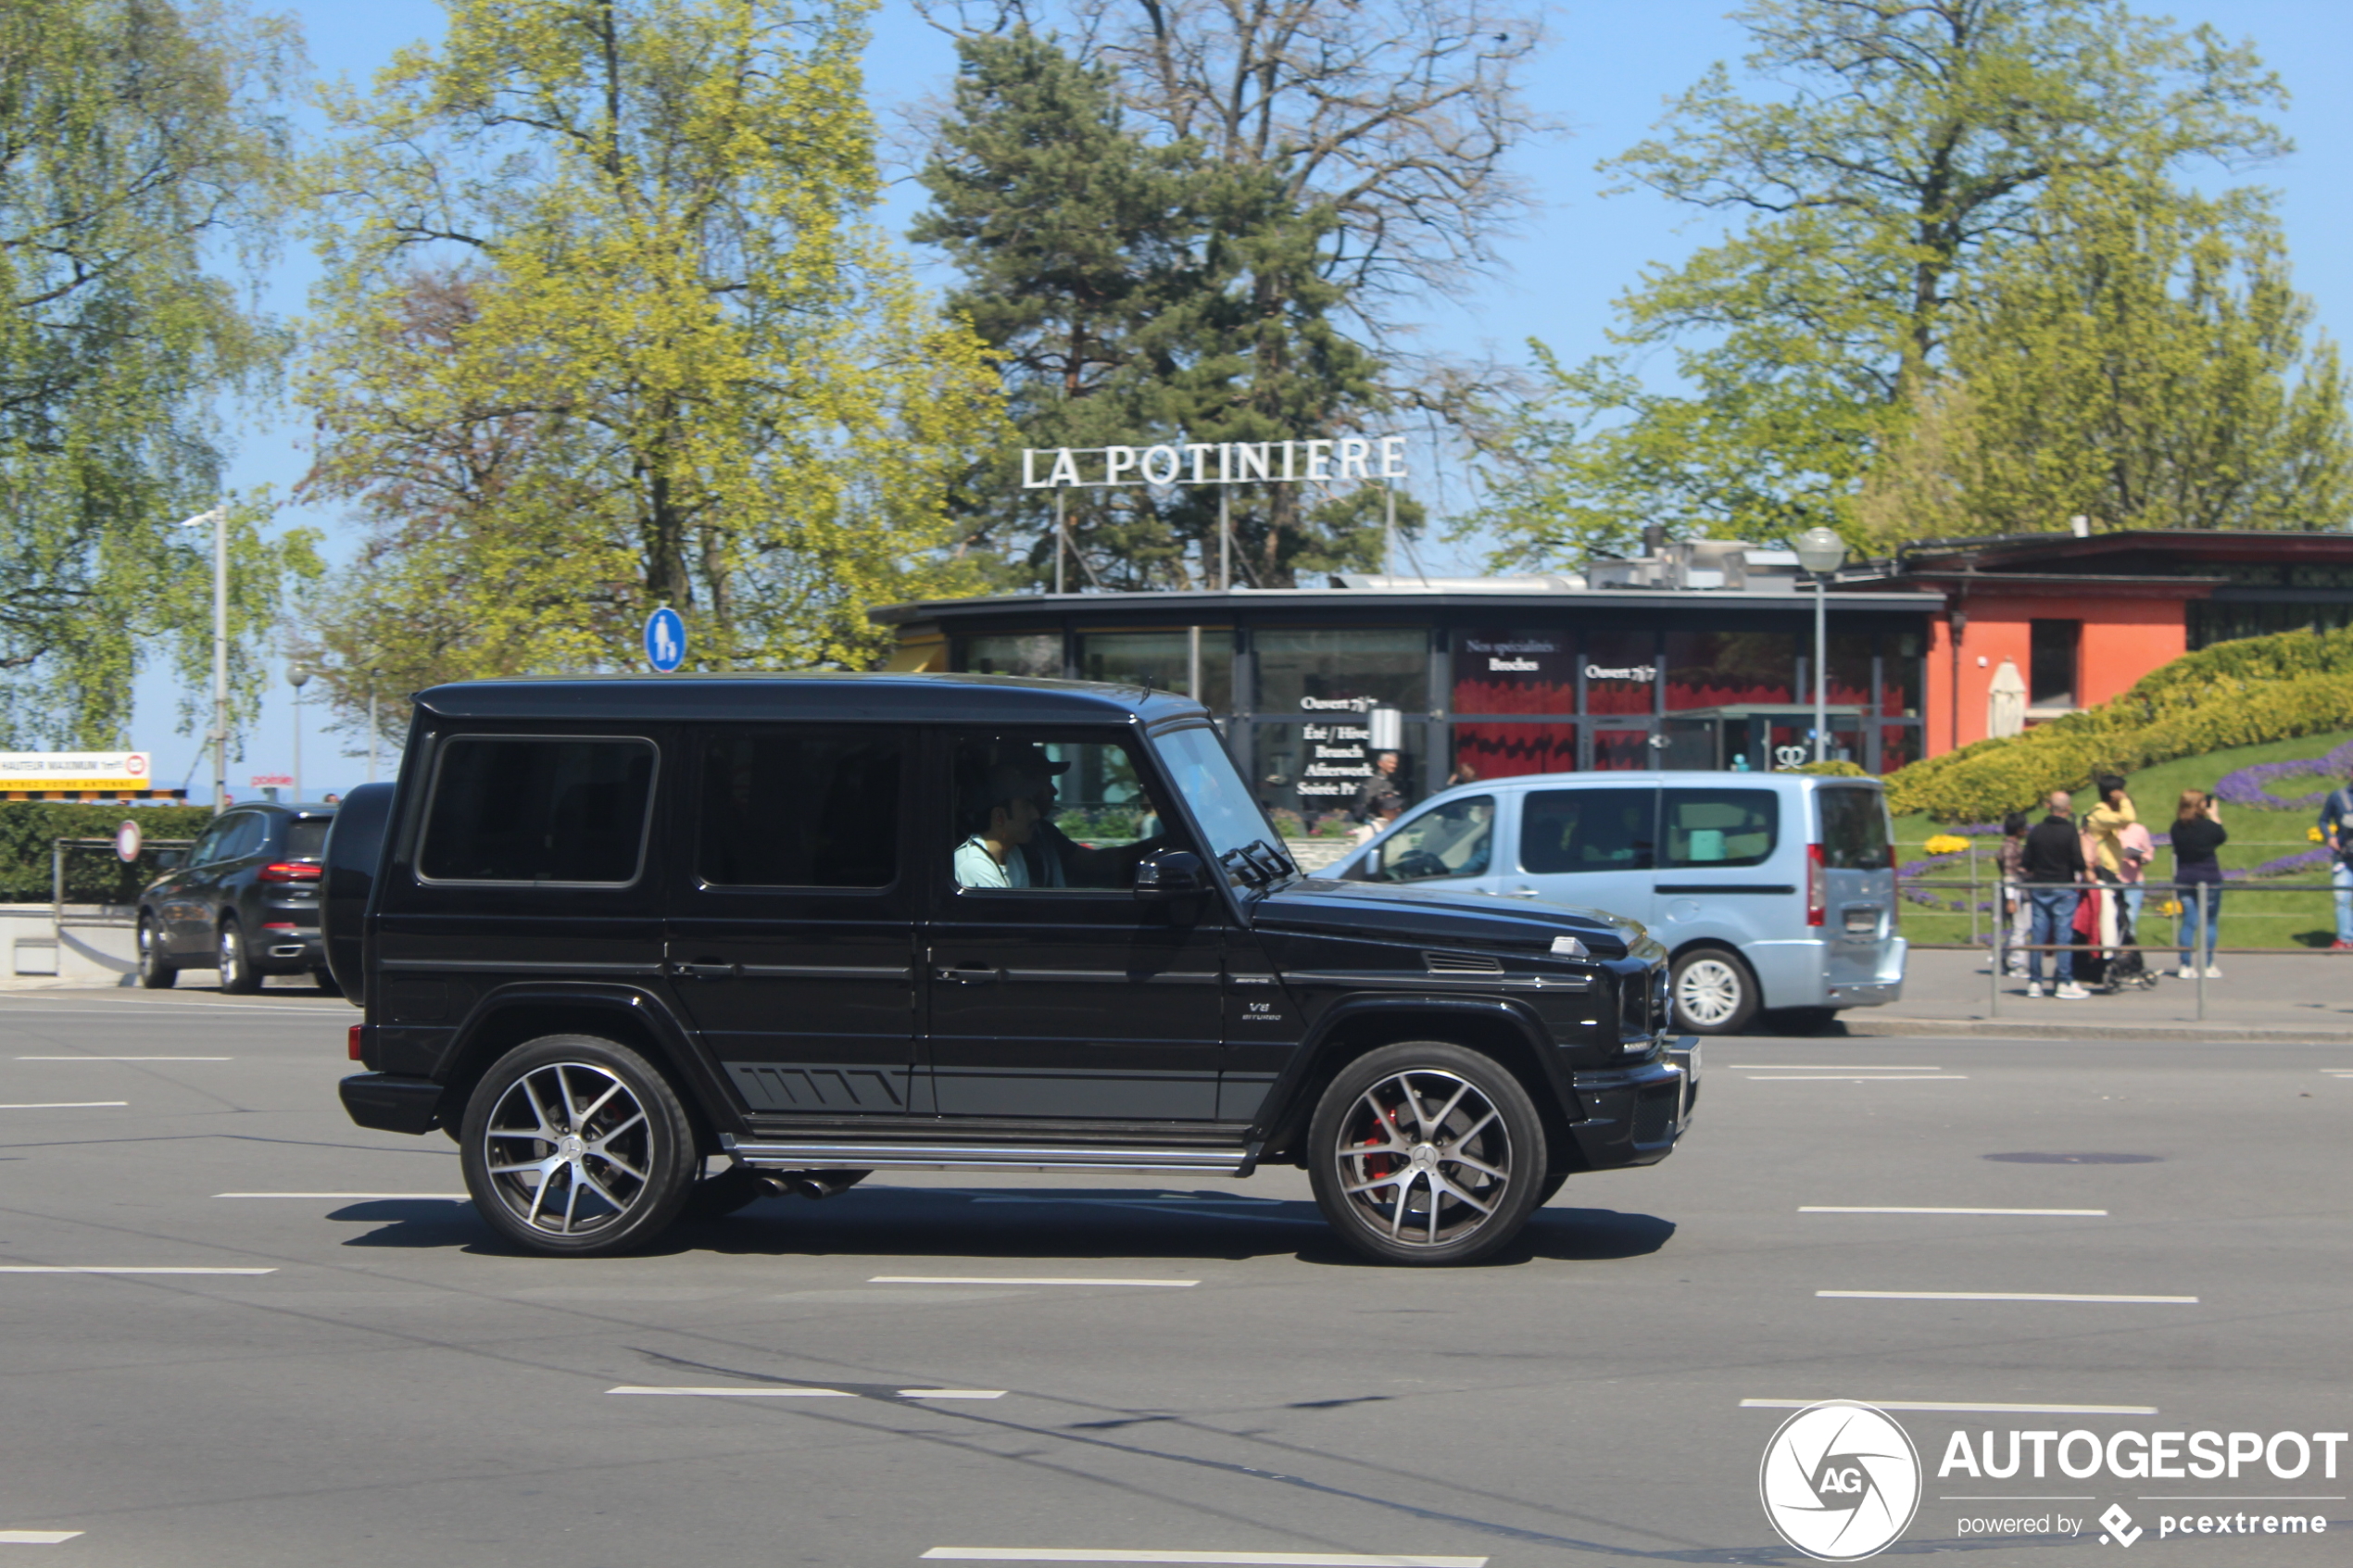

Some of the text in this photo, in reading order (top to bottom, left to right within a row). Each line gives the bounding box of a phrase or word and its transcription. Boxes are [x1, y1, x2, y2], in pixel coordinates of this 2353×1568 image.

[1021, 436, 1408, 487] LA POTINIERE
[1584, 664, 1630, 679] Ouvert
[1300, 696, 1350, 709] Ouvert
[1337, 726, 1370, 740] Hive
[1315, 744, 1365, 759] Brunch
[1304, 762, 1374, 777] Afterwork
[1296, 782, 1340, 796] Soirée
[1250, 1003, 1270, 1012] V8
